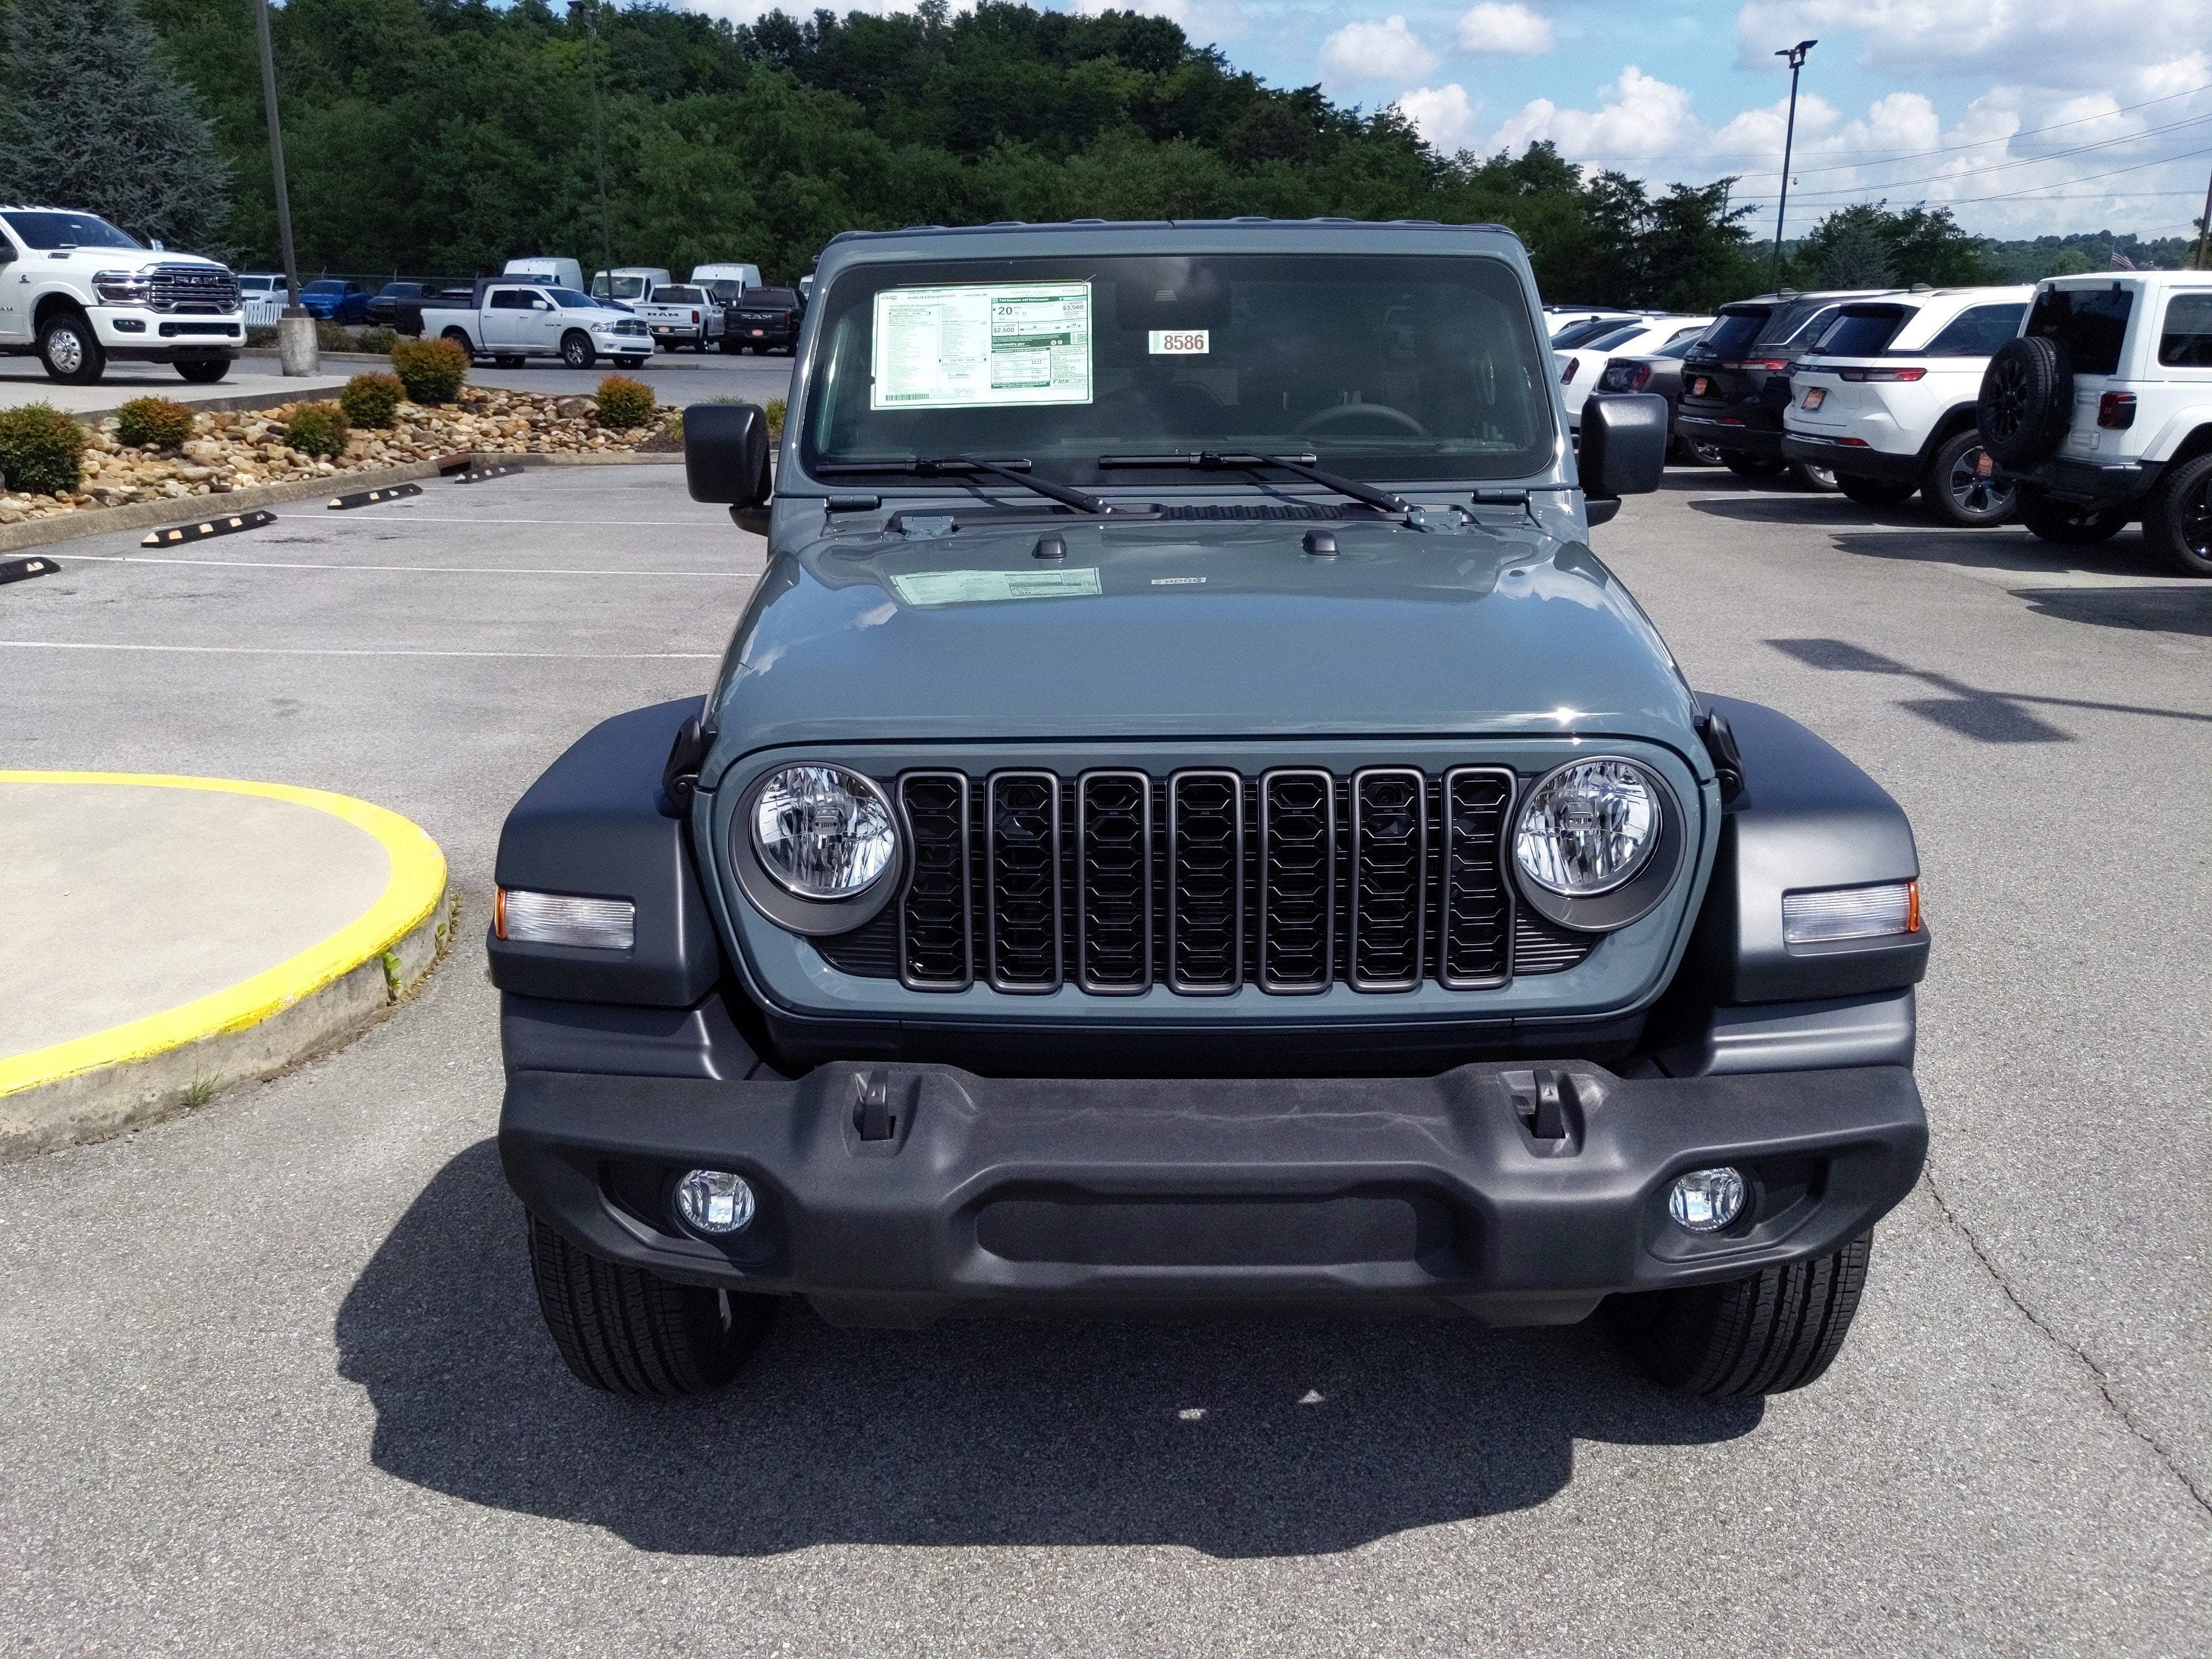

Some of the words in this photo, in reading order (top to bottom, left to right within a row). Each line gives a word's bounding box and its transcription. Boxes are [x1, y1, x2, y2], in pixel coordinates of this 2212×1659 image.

[176, 276, 219, 286] RAM
[998, 307, 1013, 315] 20
[1164, 335, 1204, 350] 8586
